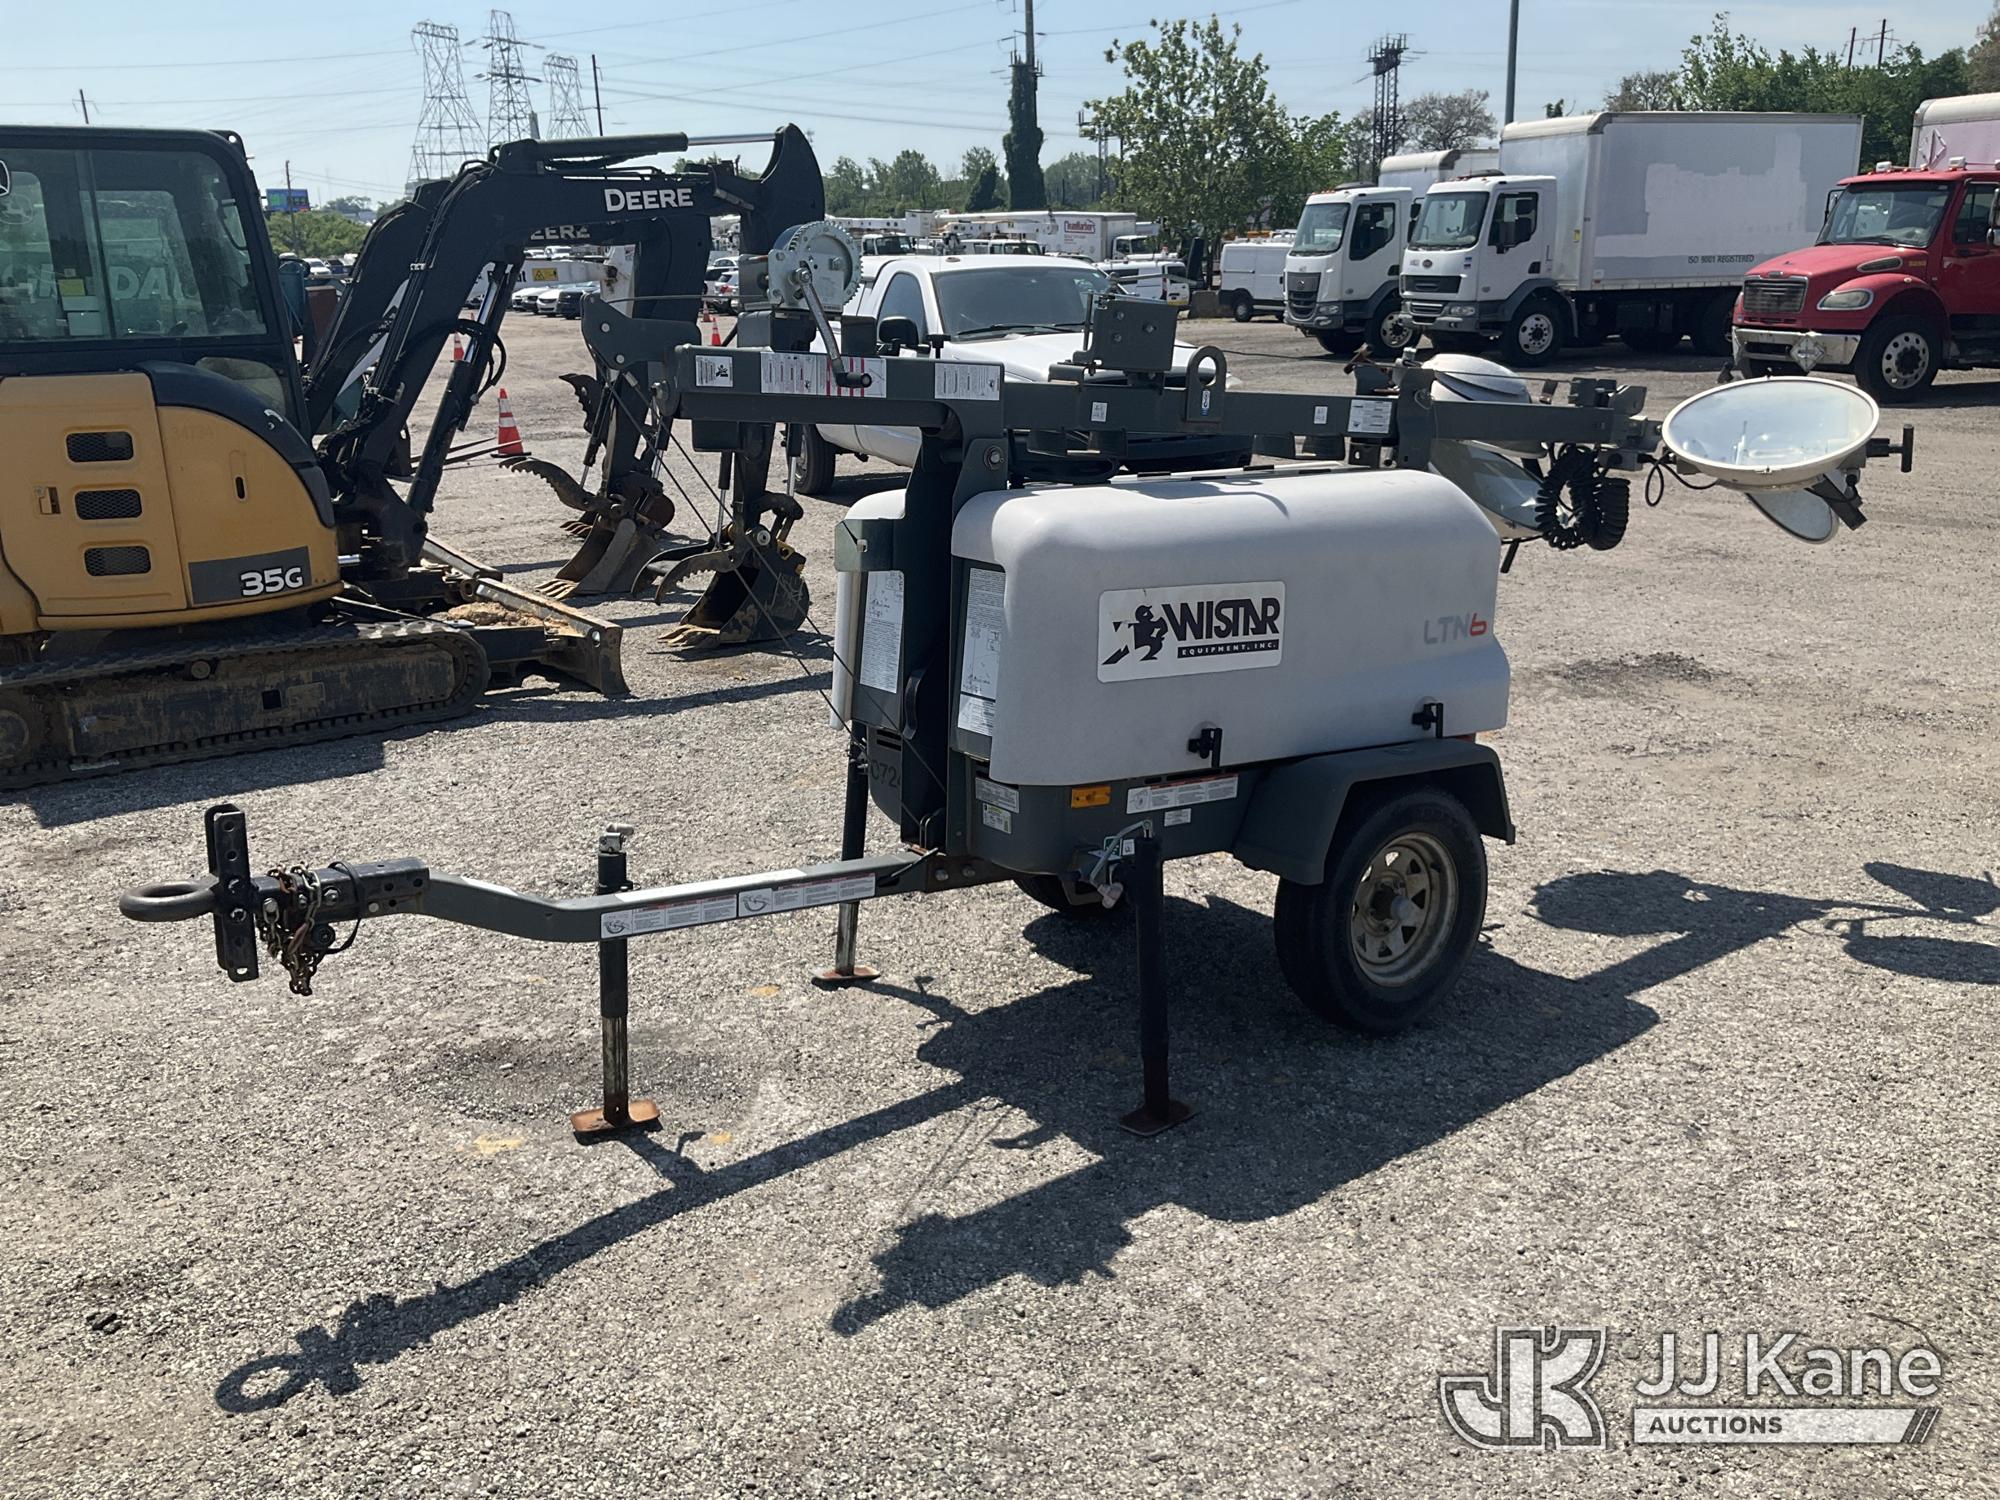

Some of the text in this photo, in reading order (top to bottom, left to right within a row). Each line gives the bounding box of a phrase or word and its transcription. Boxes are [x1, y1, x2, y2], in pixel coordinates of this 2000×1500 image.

[604, 187, 694, 212] DEERE
[1687, 254, 1755, 264] ISO 9001 REGISTERED
[241, 567, 304, 596] 35G
[1161, 597, 1281, 642] WISTAR
[1423, 612, 1488, 645] LTN6
[1254, 642, 1277, 650] INC.
